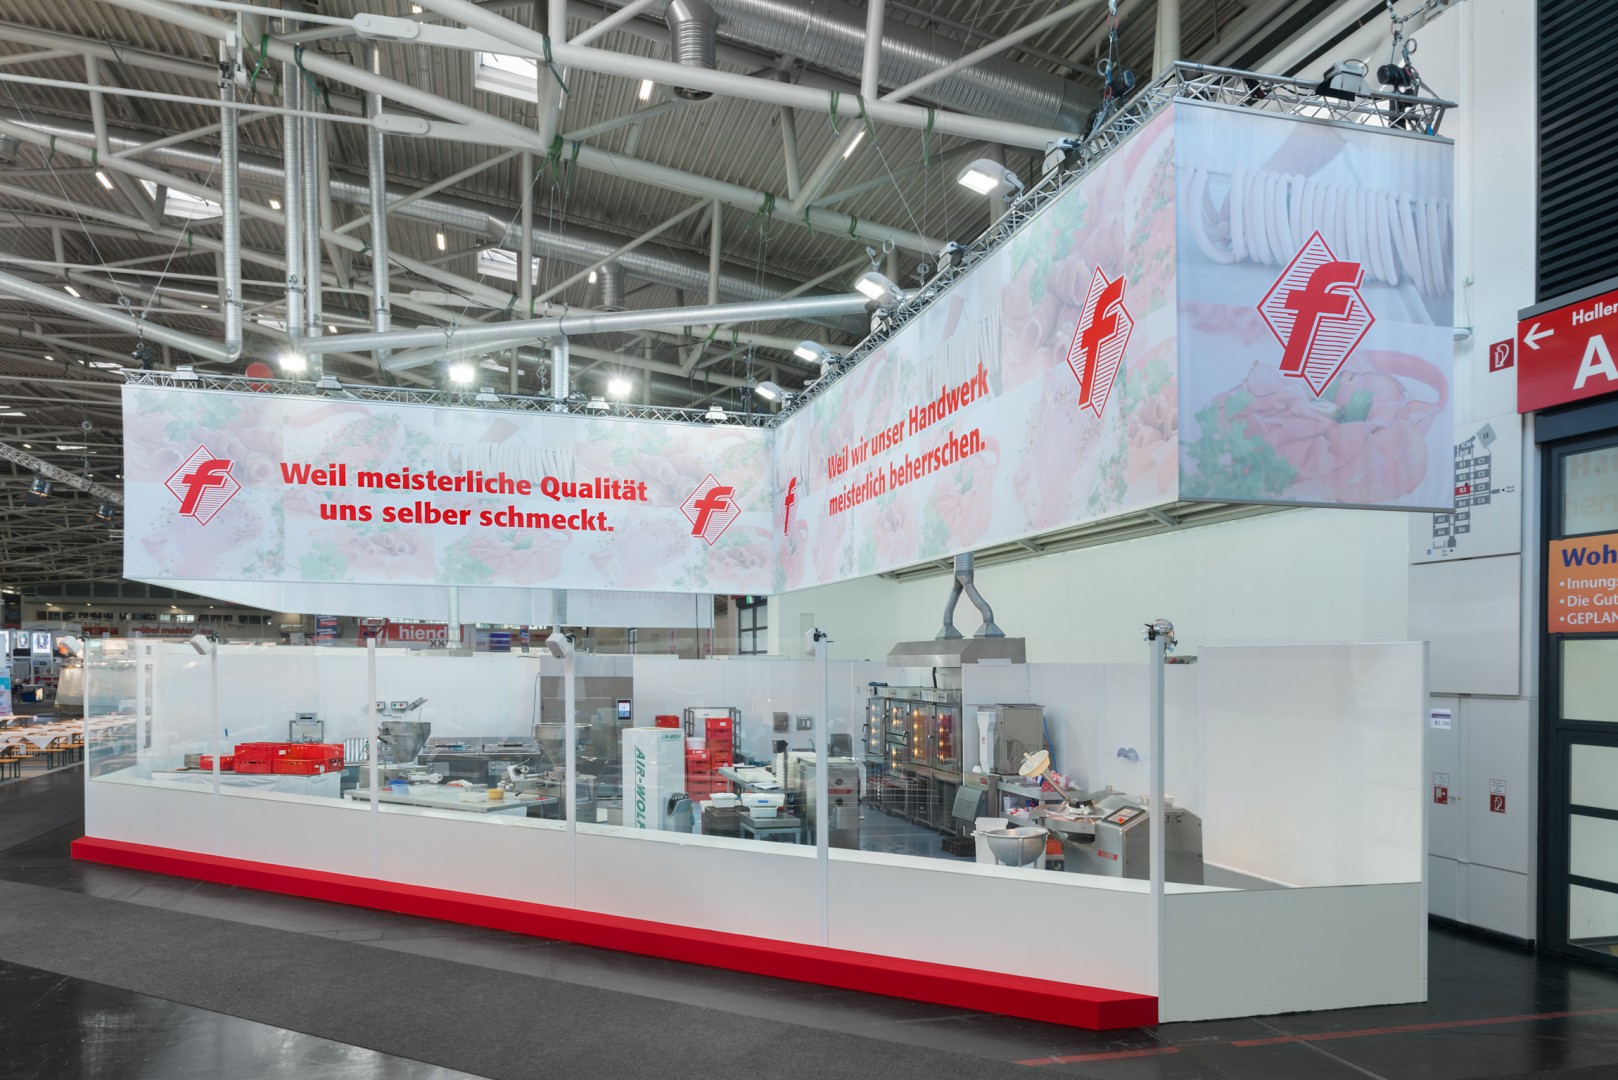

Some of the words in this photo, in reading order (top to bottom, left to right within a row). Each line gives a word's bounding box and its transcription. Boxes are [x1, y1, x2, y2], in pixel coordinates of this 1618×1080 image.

[1573, 334, 1618, 390] A
[827, 445, 849, 480] Weil
[851, 436, 869, 468] wir
[871, 418, 905, 457] unser
[908, 360, 989, 437] Handwerk
[280, 462, 347, 487] Weil
[357, 467, 531, 496] meisterliche
[541, 475, 648, 502] Qualität
[828, 467, 886, 516] meisterlich
[889, 427, 986, 491] beherrschen.
[320, 503, 373, 522] uns
[383, 501, 472, 526] selber
[479, 505, 614, 532] schmeckt.
[1562, 544, 1618, 567] Woh
[1567, 595, 1590, 607] Die
[1593, 593, 1618, 606] Gut
